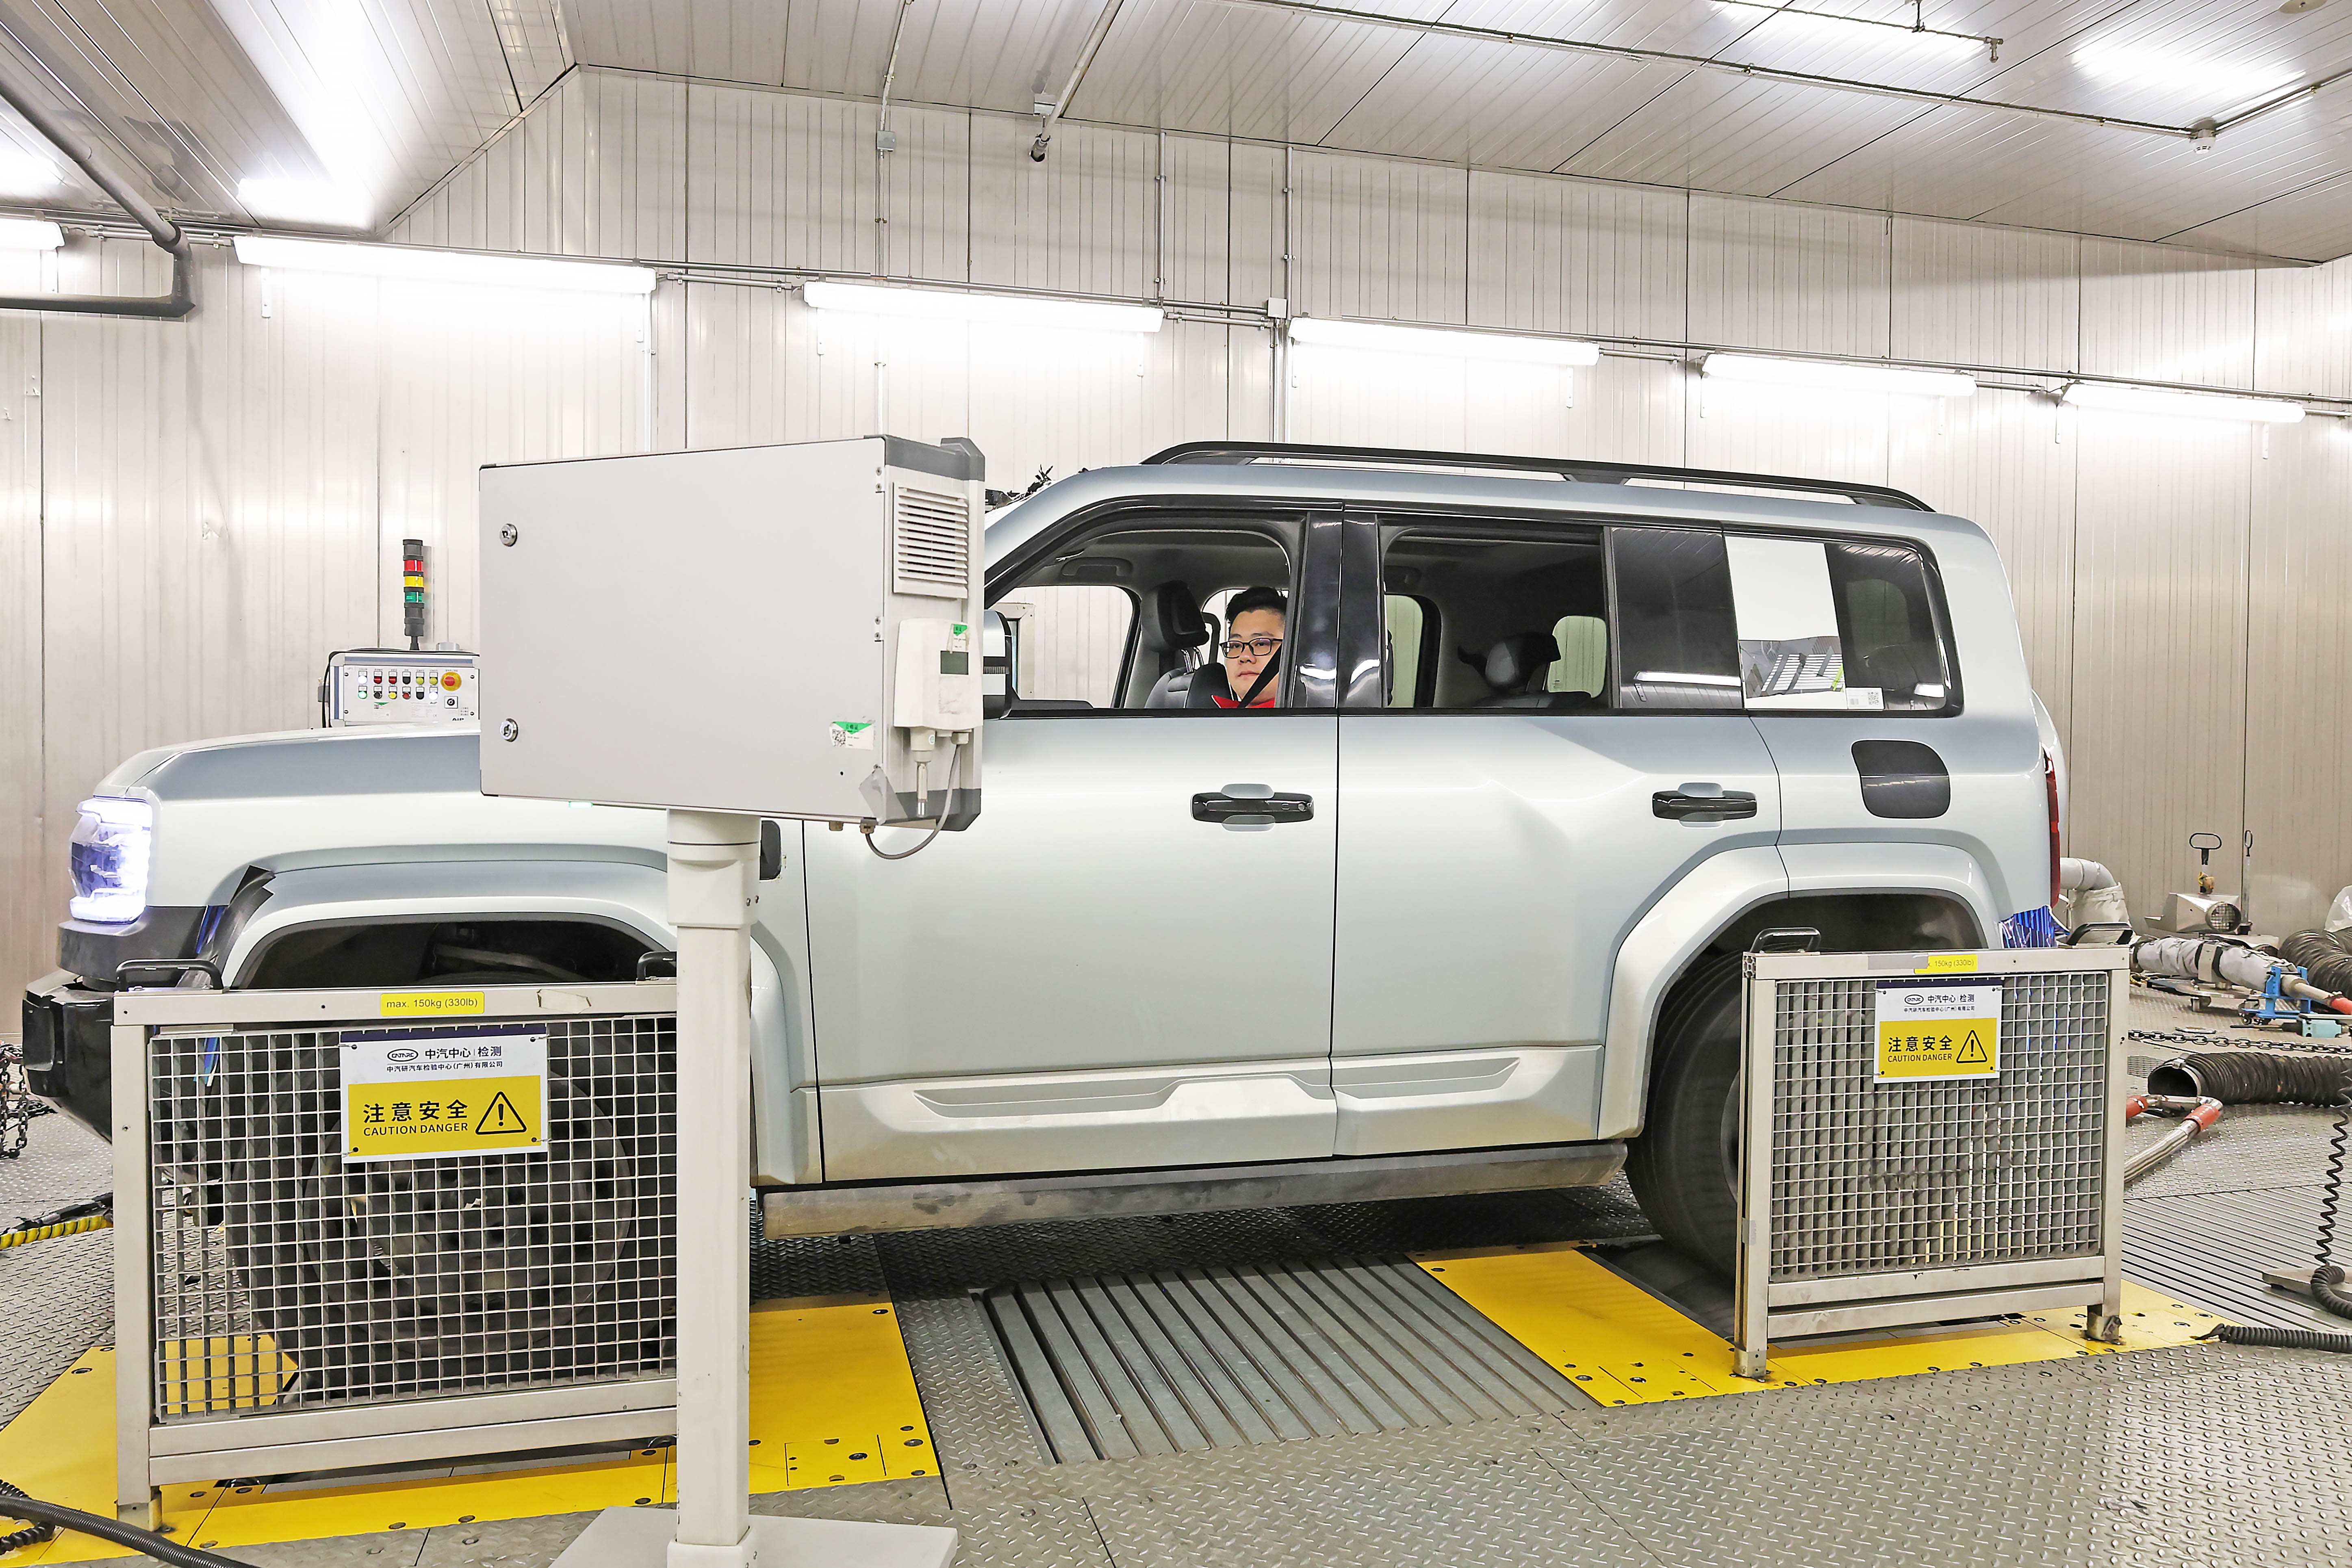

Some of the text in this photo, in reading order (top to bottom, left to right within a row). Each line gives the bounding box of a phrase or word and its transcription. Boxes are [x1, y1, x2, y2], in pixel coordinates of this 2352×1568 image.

[414, 999, 441, 1008] 150kg
[445, 998, 478, 1008] (330lb)
[1928, 994, 1974, 1003] 中汽中心 检测
[1888, 1035, 1953, 1052] 注意安全
[425, 1046, 501, 1059] 中汽中心 检测
[363, 1099, 468, 1123] 注意安全
[364, 1123, 468, 1136] CAUTION DANGER
